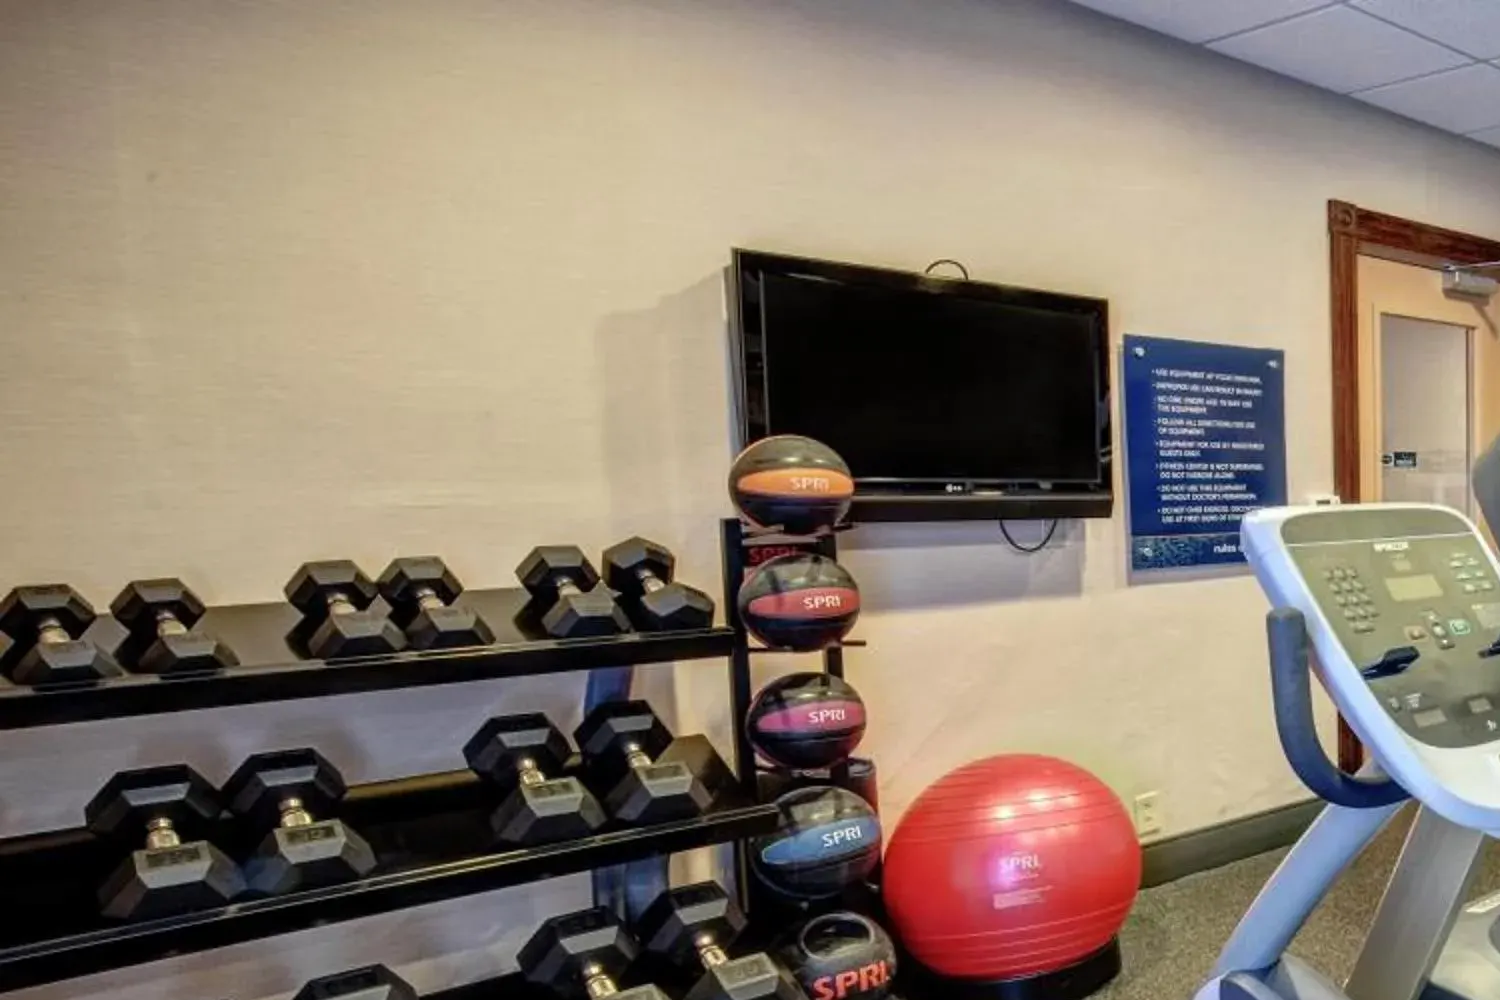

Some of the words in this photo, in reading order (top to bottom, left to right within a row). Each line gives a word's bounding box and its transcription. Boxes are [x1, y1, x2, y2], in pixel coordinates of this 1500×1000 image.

[789, 477, 830, 491] SPRI
[803, 595, 841, 609] SPRI
[808, 709, 845, 724] SPRI
[822, 825, 863, 848] SPRI
